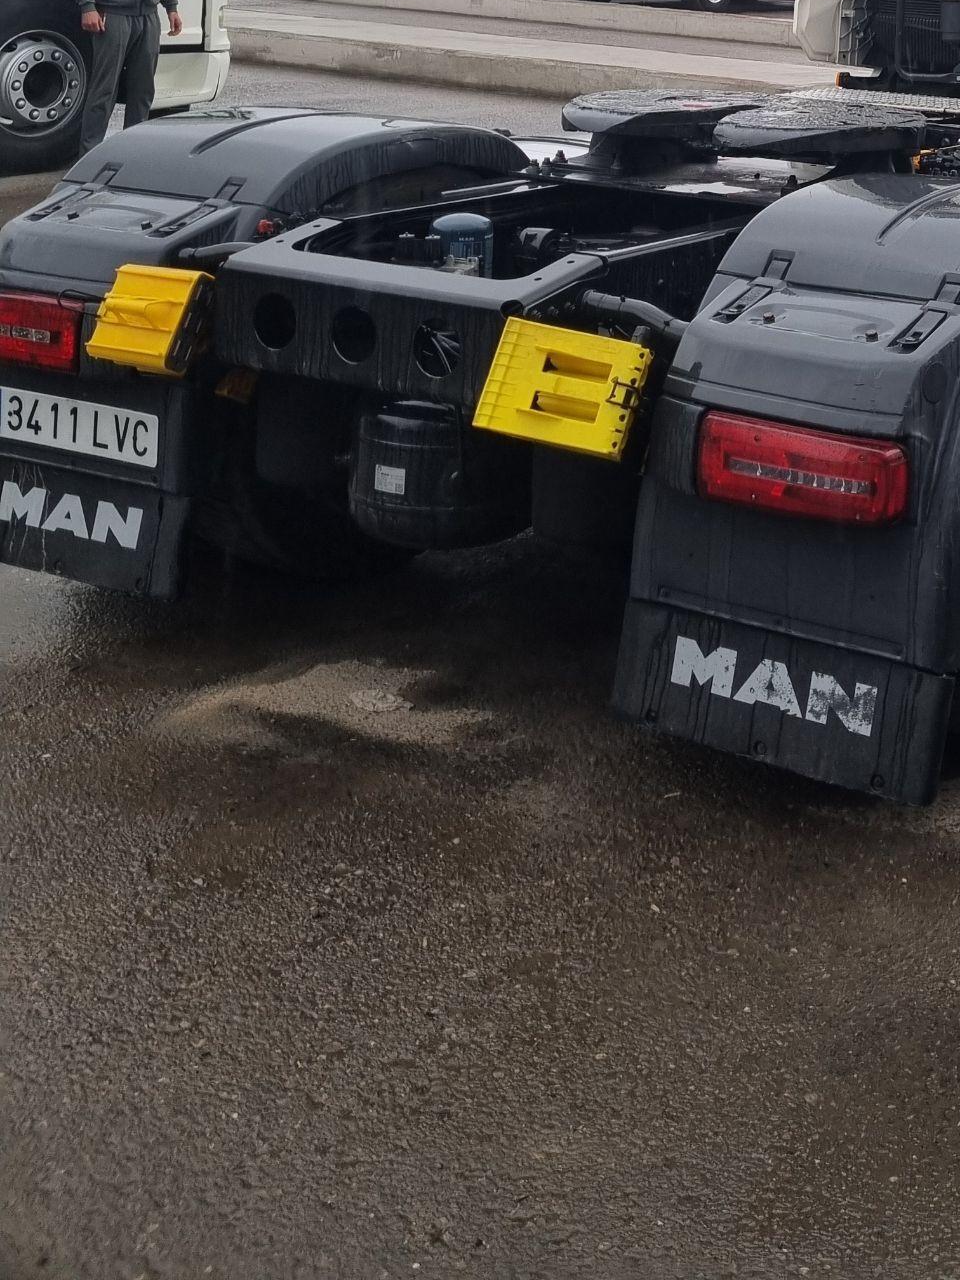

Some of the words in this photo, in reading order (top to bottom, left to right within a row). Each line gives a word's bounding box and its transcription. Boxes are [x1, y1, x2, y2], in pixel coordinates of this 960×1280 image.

[7, 395, 79, 444] 3411
[92, 410, 149, 457] LVC
[0, 480, 144, 550] MAN
[671, 635, 878, 737] MAN
